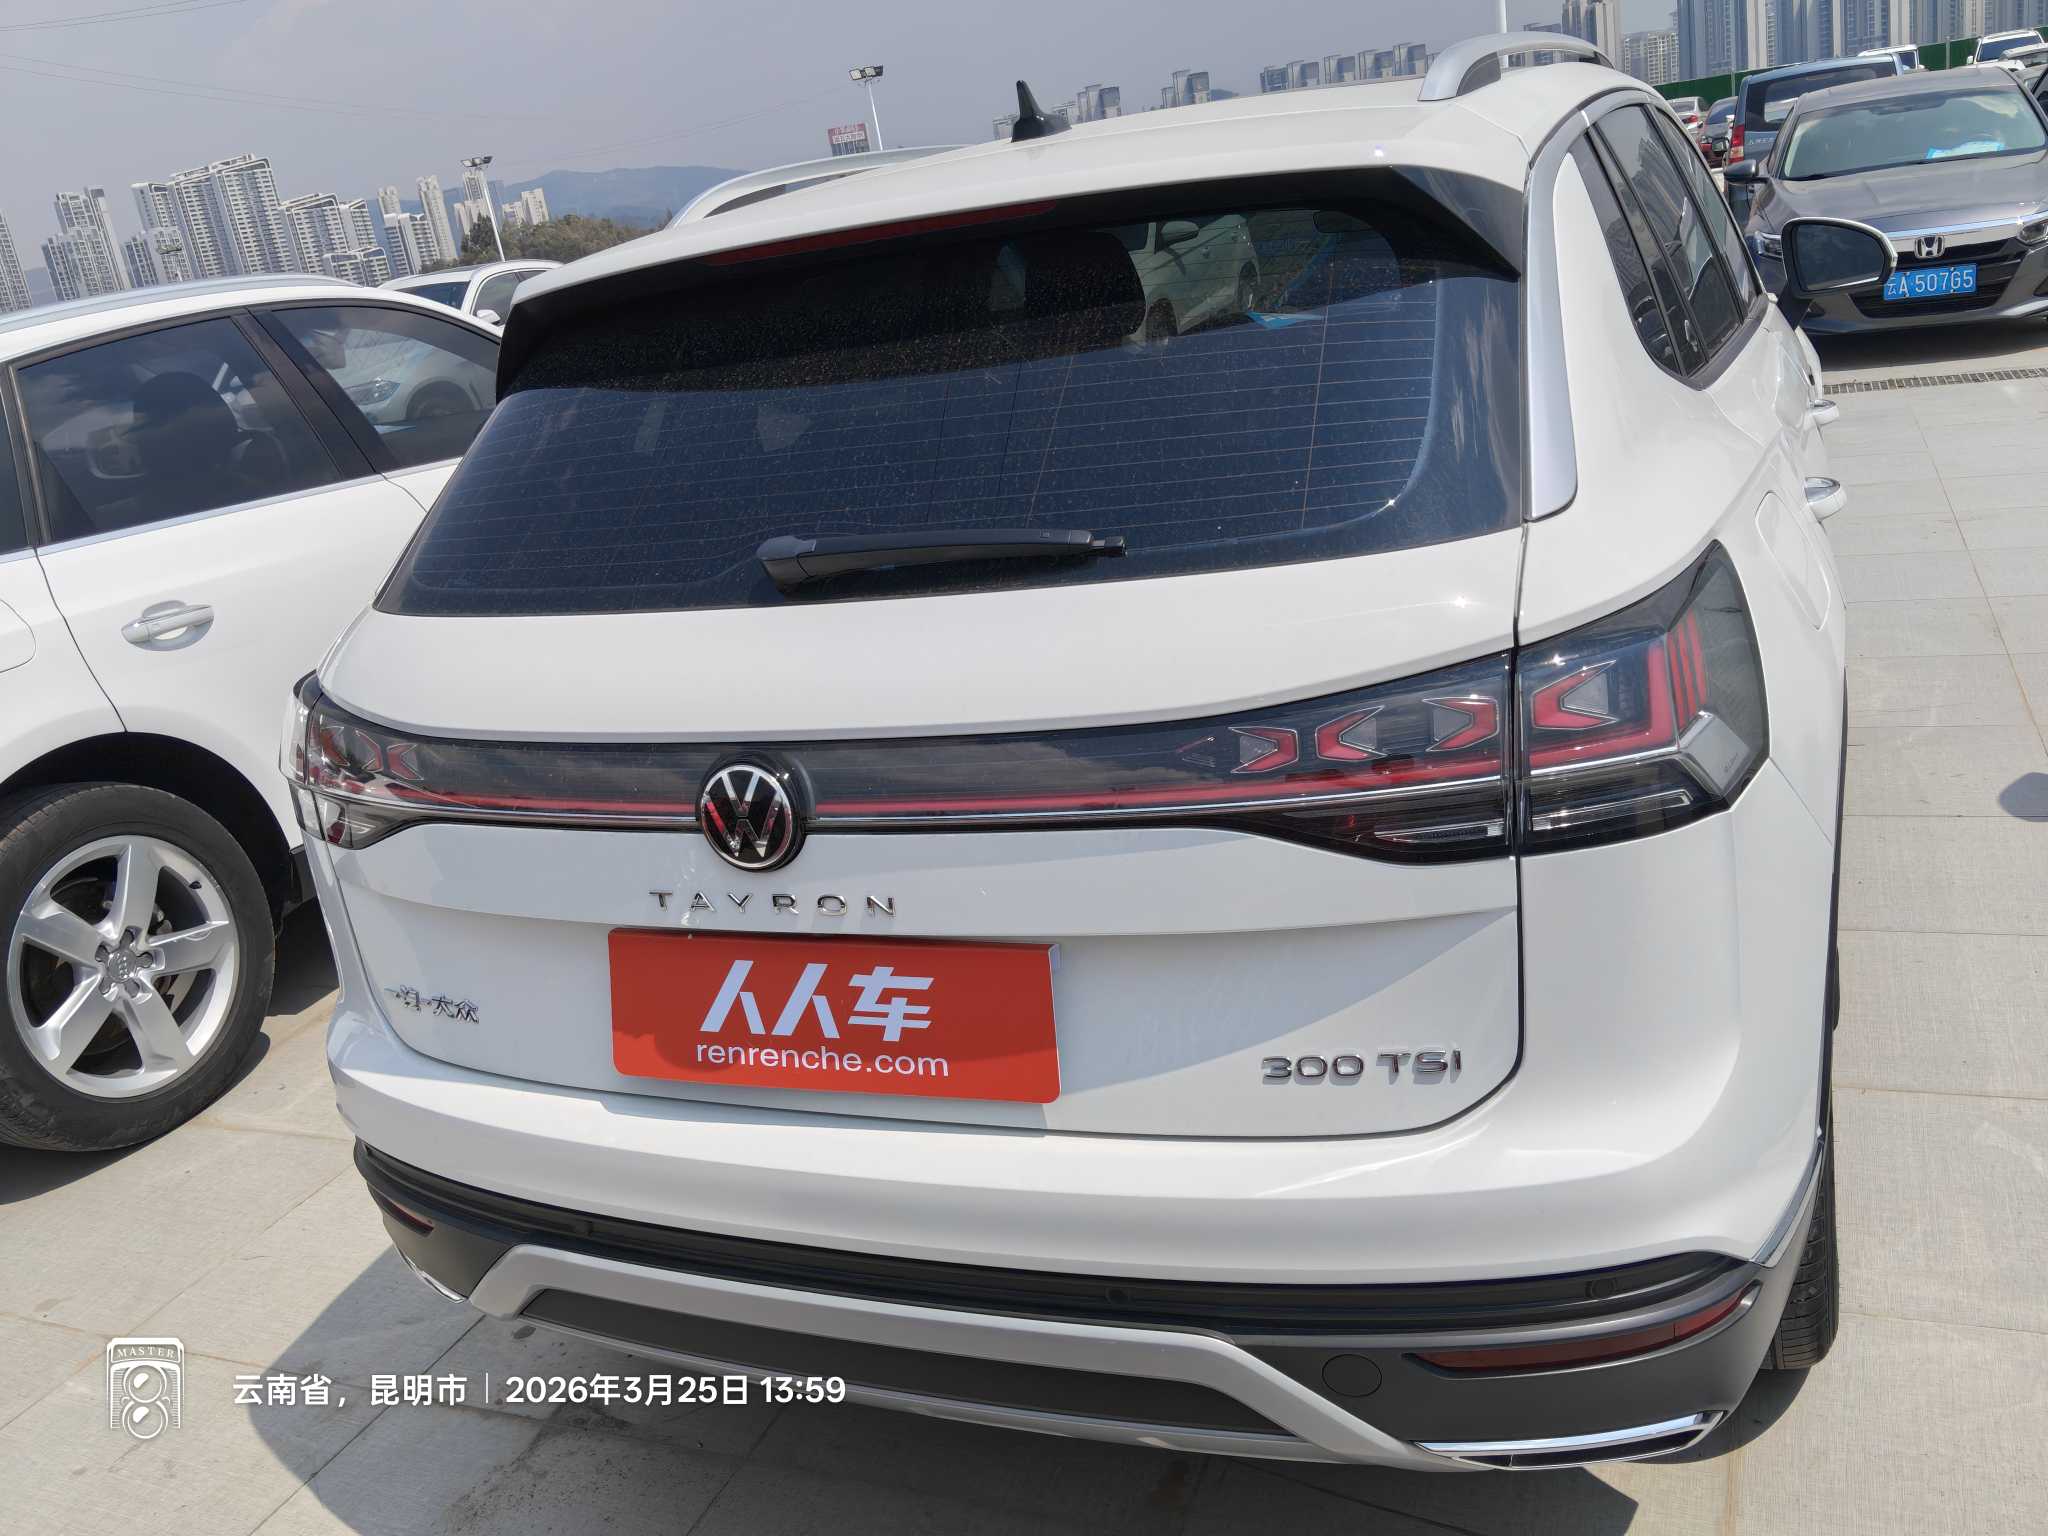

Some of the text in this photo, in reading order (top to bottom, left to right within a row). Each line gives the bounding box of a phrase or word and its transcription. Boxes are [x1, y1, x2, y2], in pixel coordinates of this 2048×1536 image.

[649, 889, 897, 918] TAYRON
[699, 959, 935, 1042] 人人车
[696, 1042, 949, 1077] renrenche.com
[1262, 1050, 1461, 1078] 300 TSI
